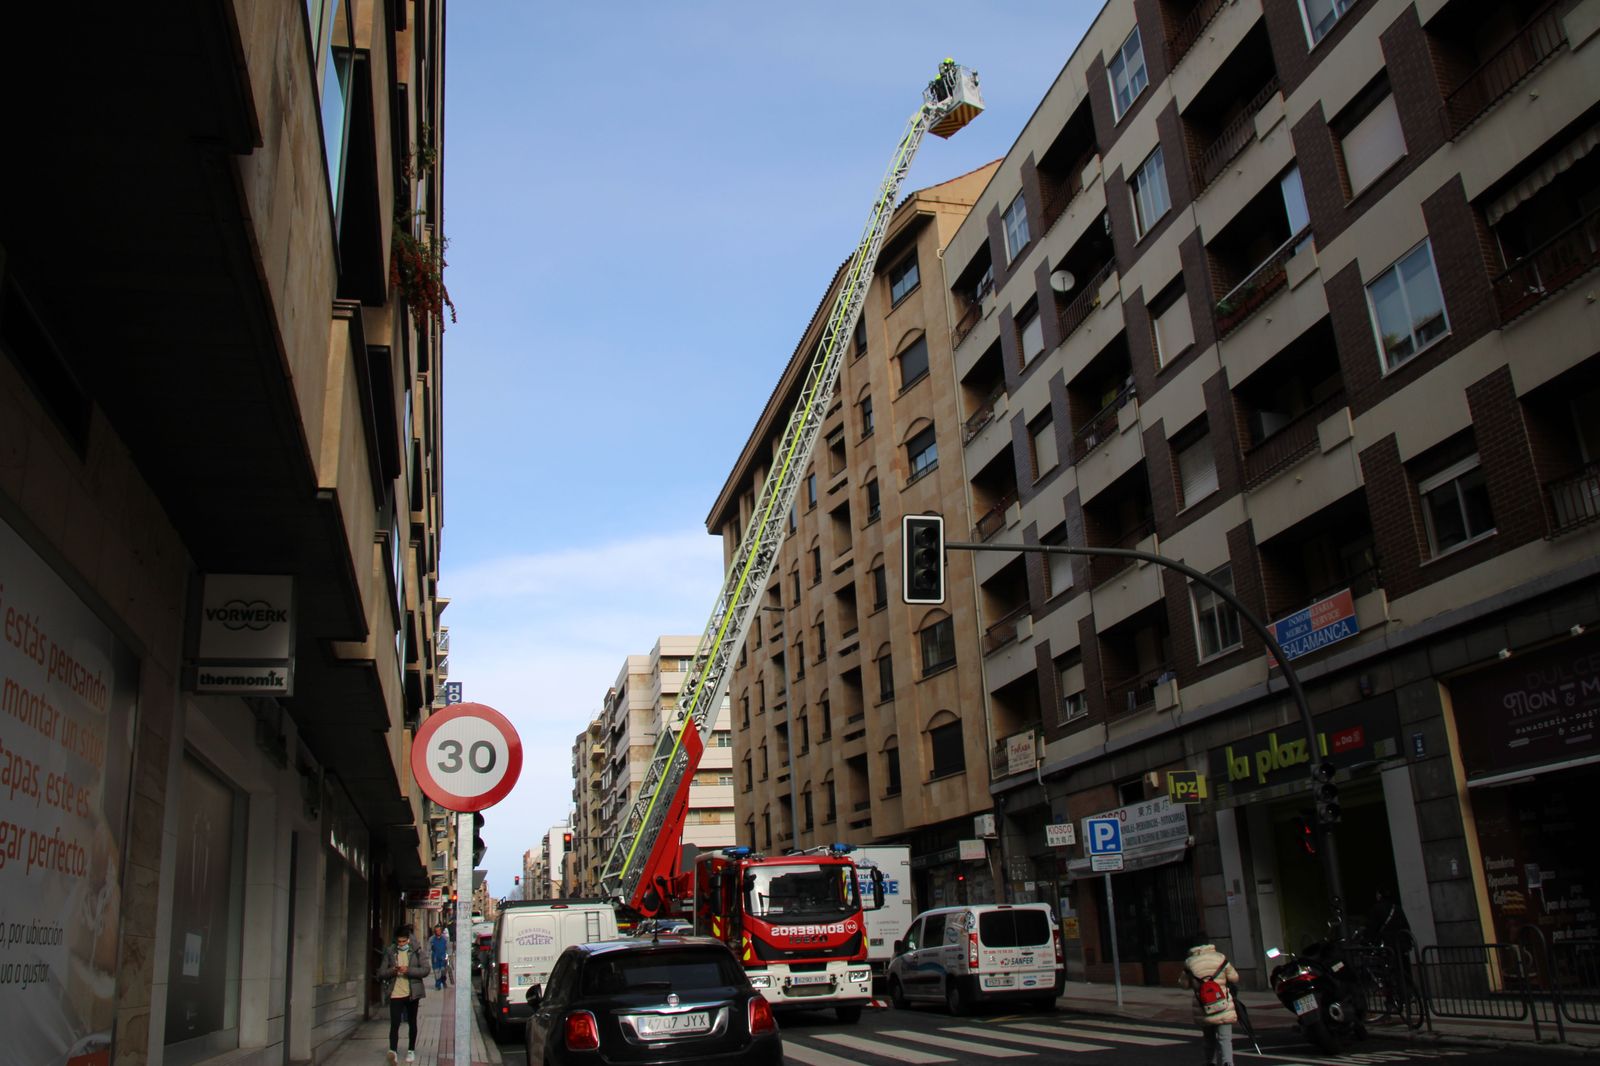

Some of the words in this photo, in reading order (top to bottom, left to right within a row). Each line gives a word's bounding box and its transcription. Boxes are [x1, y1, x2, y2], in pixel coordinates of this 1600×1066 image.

[205, 608, 287, 622] VORWERK
[1282, 620, 1351, 659] SALAMANCA
[4, 606, 47, 666] estás
[47, 640, 107, 712] pensando
[199, 670, 284, 686] thermomix
[2, 676, 61, 740] montar
[61, 714, 77, 750] un
[437, 740, 497, 775] 30
[1225, 745, 1250, 782] la
[46, 771, 74, 813] este
[76, 785, 91, 818] es
[1048, 825, 1072, 835] KIOSCO
[1094, 823, 1115, 850] P
[26, 826, 87, 876] perfecto.
[8, 924, 25, 950] por
[26, 919, 64, 946] ubicación
[22, 960, 50, 990] gustar.
[1011, 957, 1034, 966] SANFER
[683, 1014, 707, 1028] JYX
